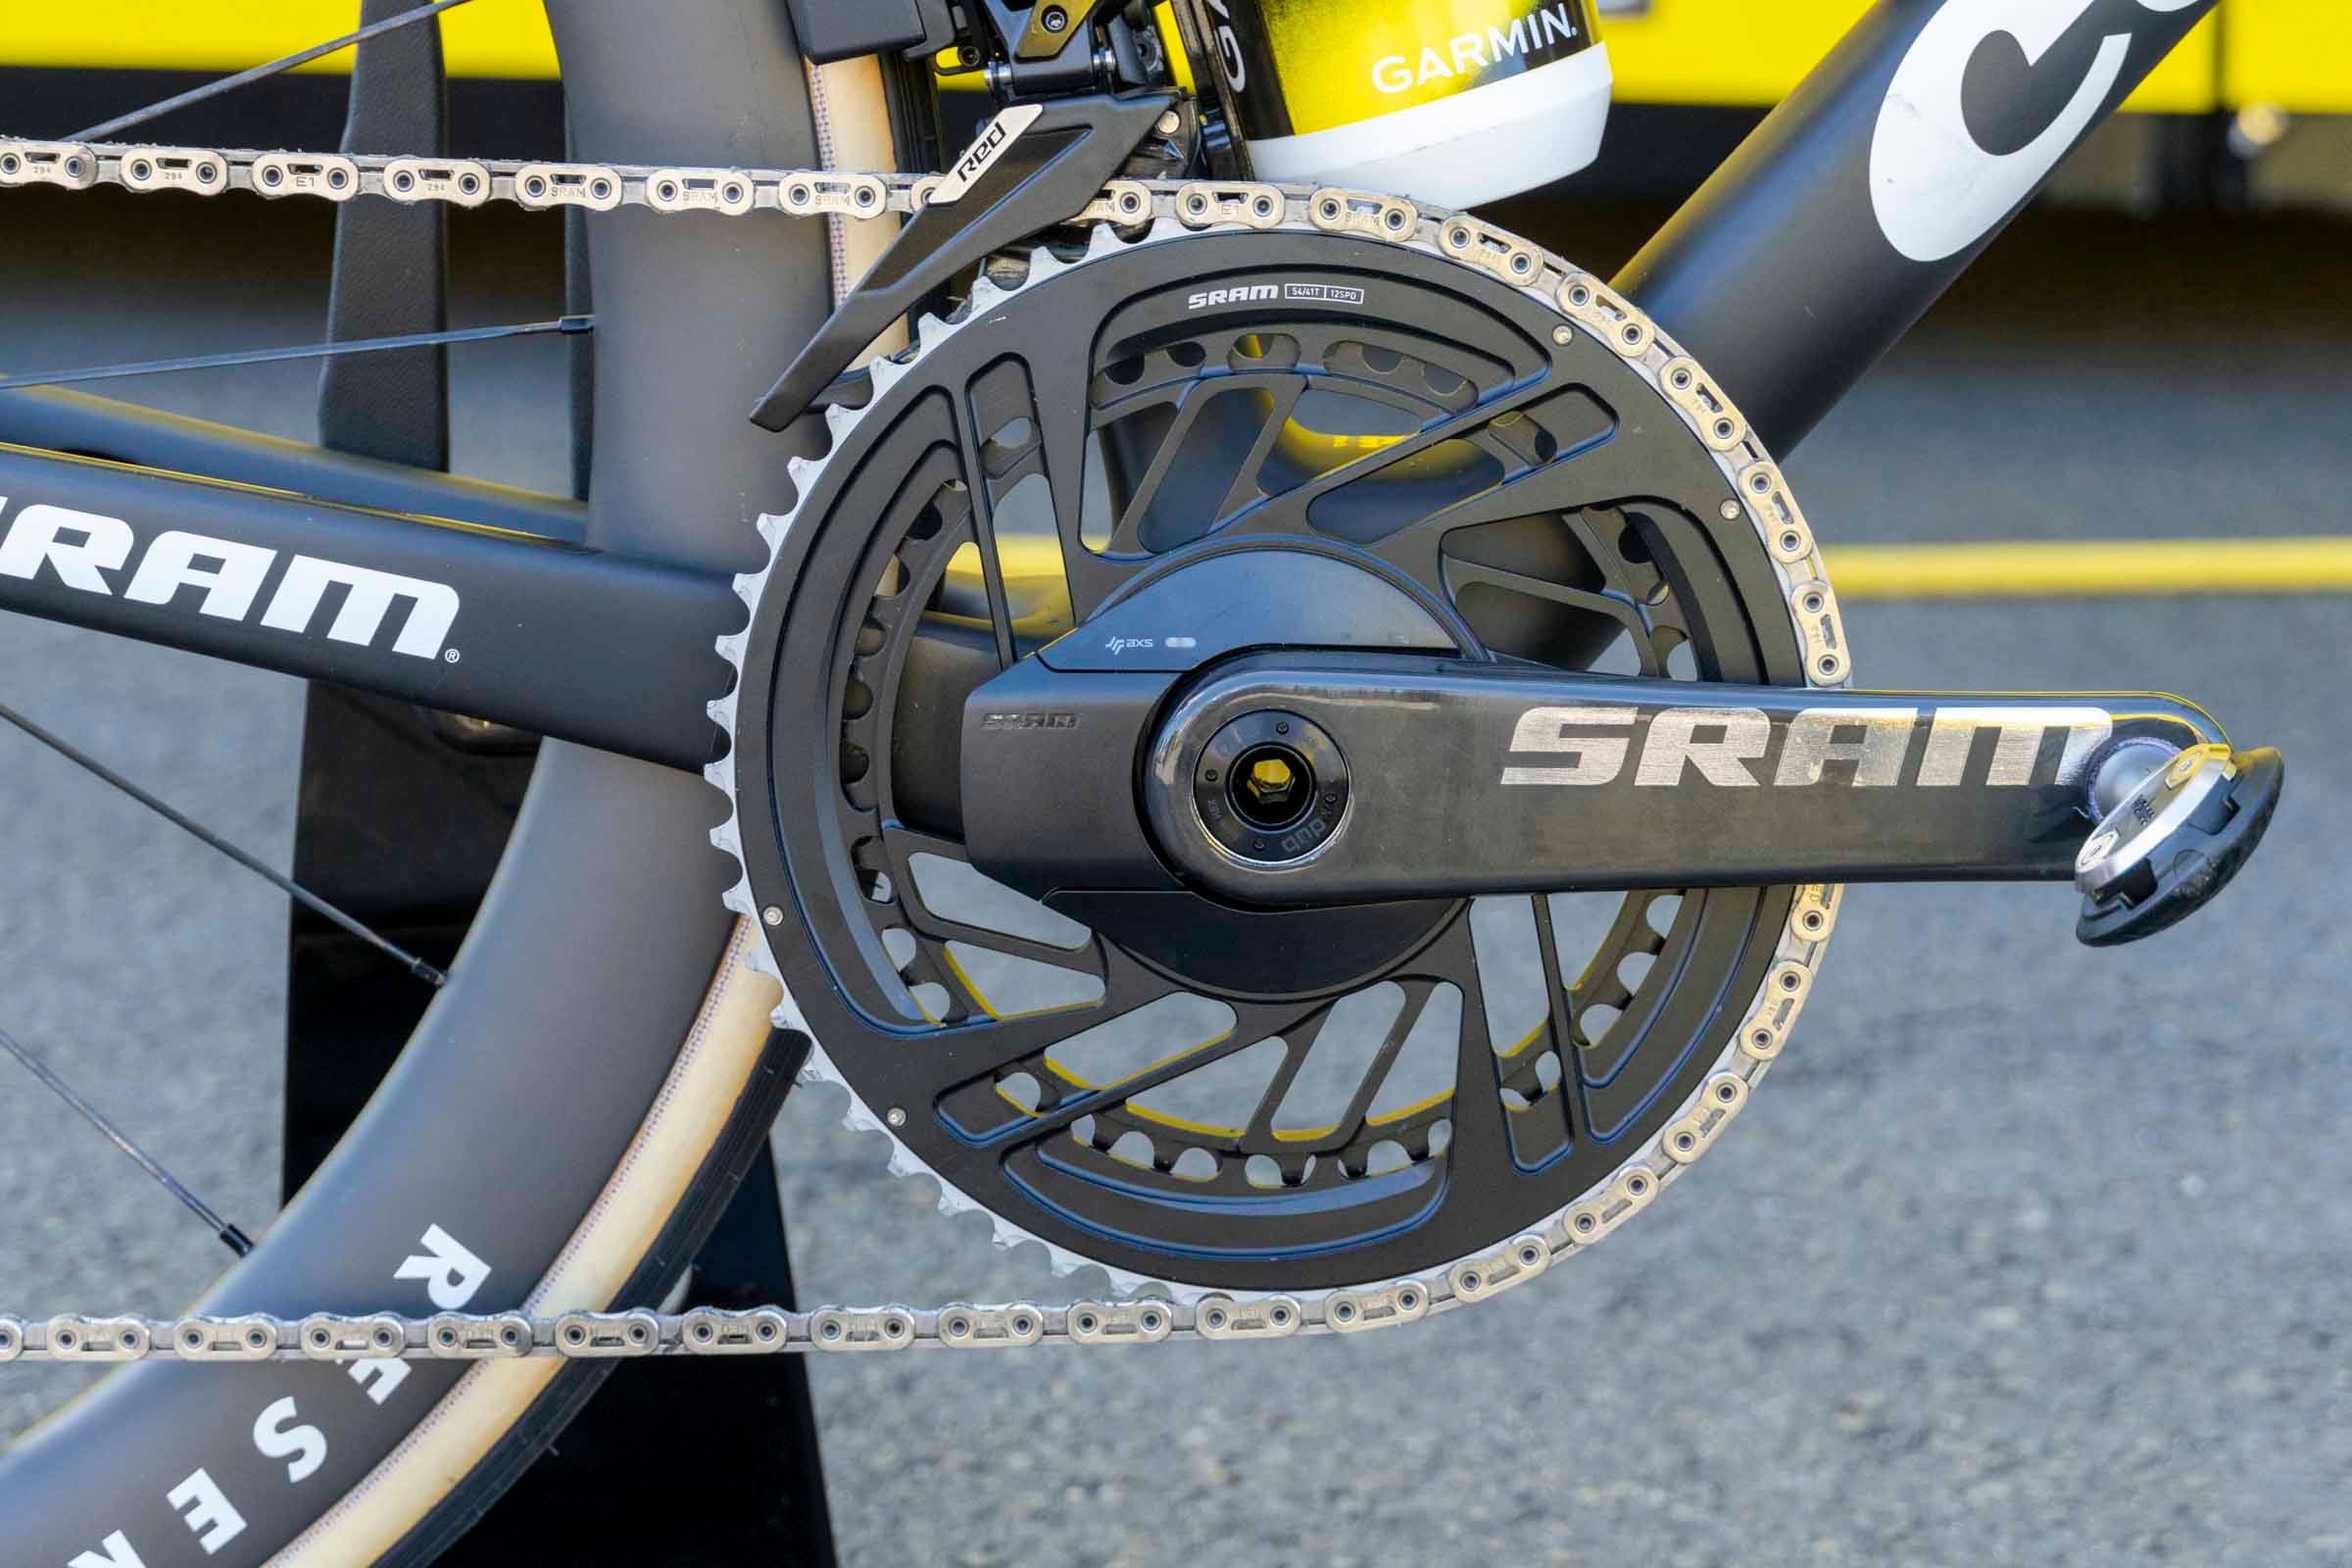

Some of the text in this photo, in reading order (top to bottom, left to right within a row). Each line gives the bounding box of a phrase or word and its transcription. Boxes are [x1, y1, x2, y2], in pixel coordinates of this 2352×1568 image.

[551, 186, 585, 198] SRAM
[1188, 284, 1278, 310] SRAM
[1292, 286, 1320, 297] 54/41T
[1500, 706, 2113, 787] SRAM
